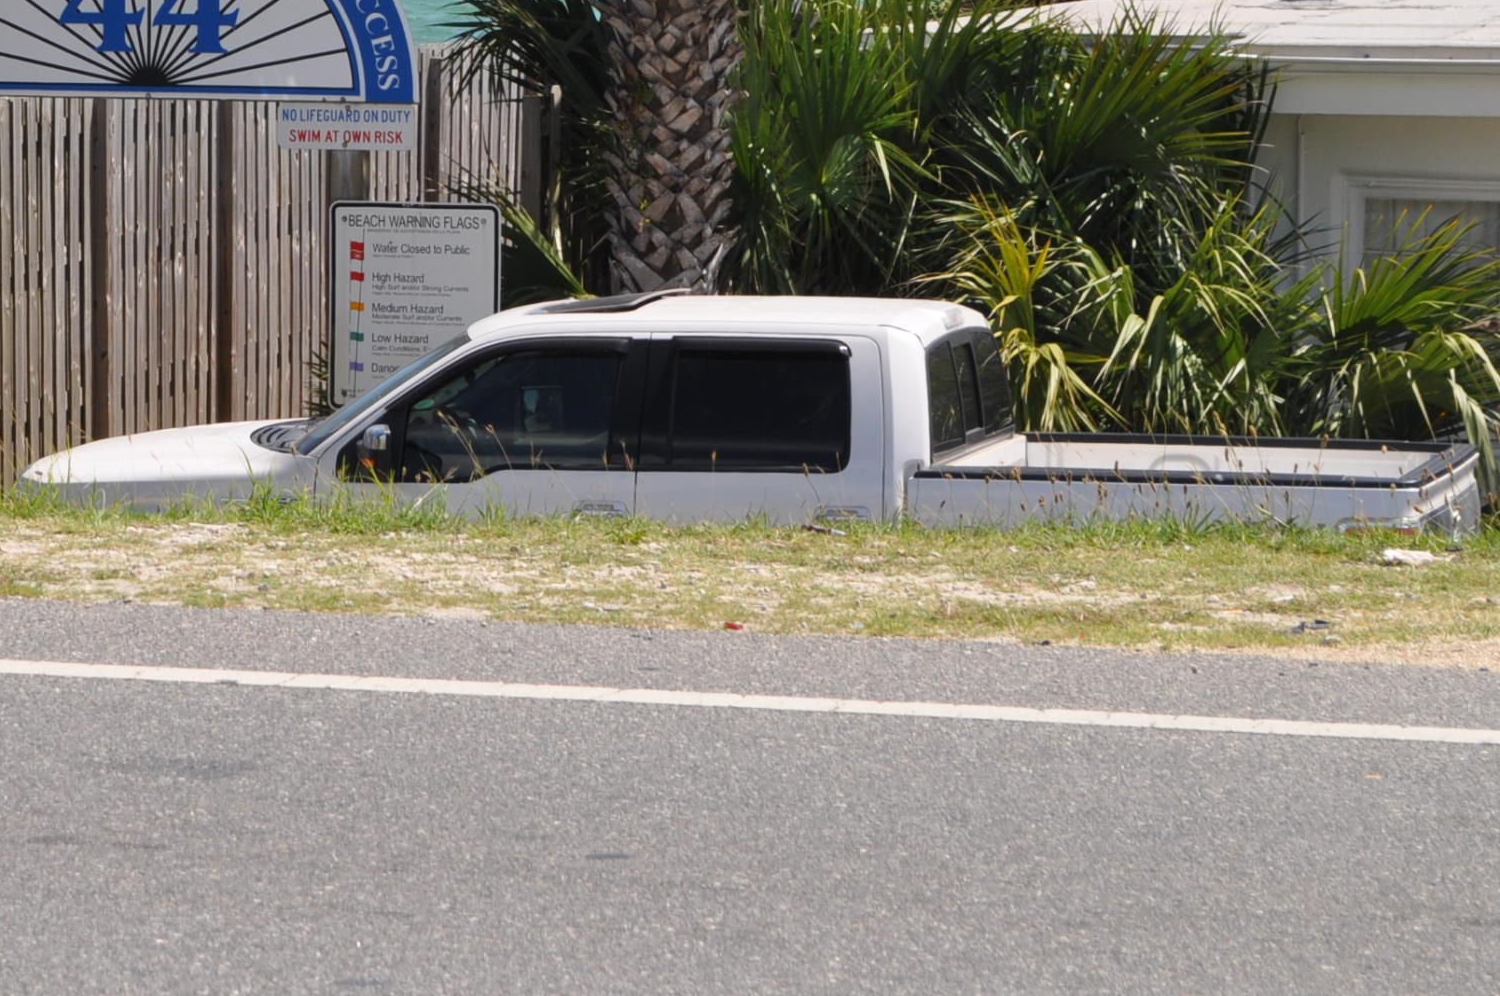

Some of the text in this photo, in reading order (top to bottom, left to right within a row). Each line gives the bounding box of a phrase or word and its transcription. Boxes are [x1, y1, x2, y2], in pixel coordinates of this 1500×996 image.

[282, 109, 411, 123] NO LIFEGUARD ON DUTY
[289, 129, 403, 144] SWIM AT OWN RISK
[349, 214, 480, 230] BEACH WARNING FLAGS
[372, 243, 470, 255] Water Closed to Public
[372, 272, 425, 284] High Hazard
[372, 303, 444, 314] Medium Hazard
[372, 333, 429, 344] Low Hazard
